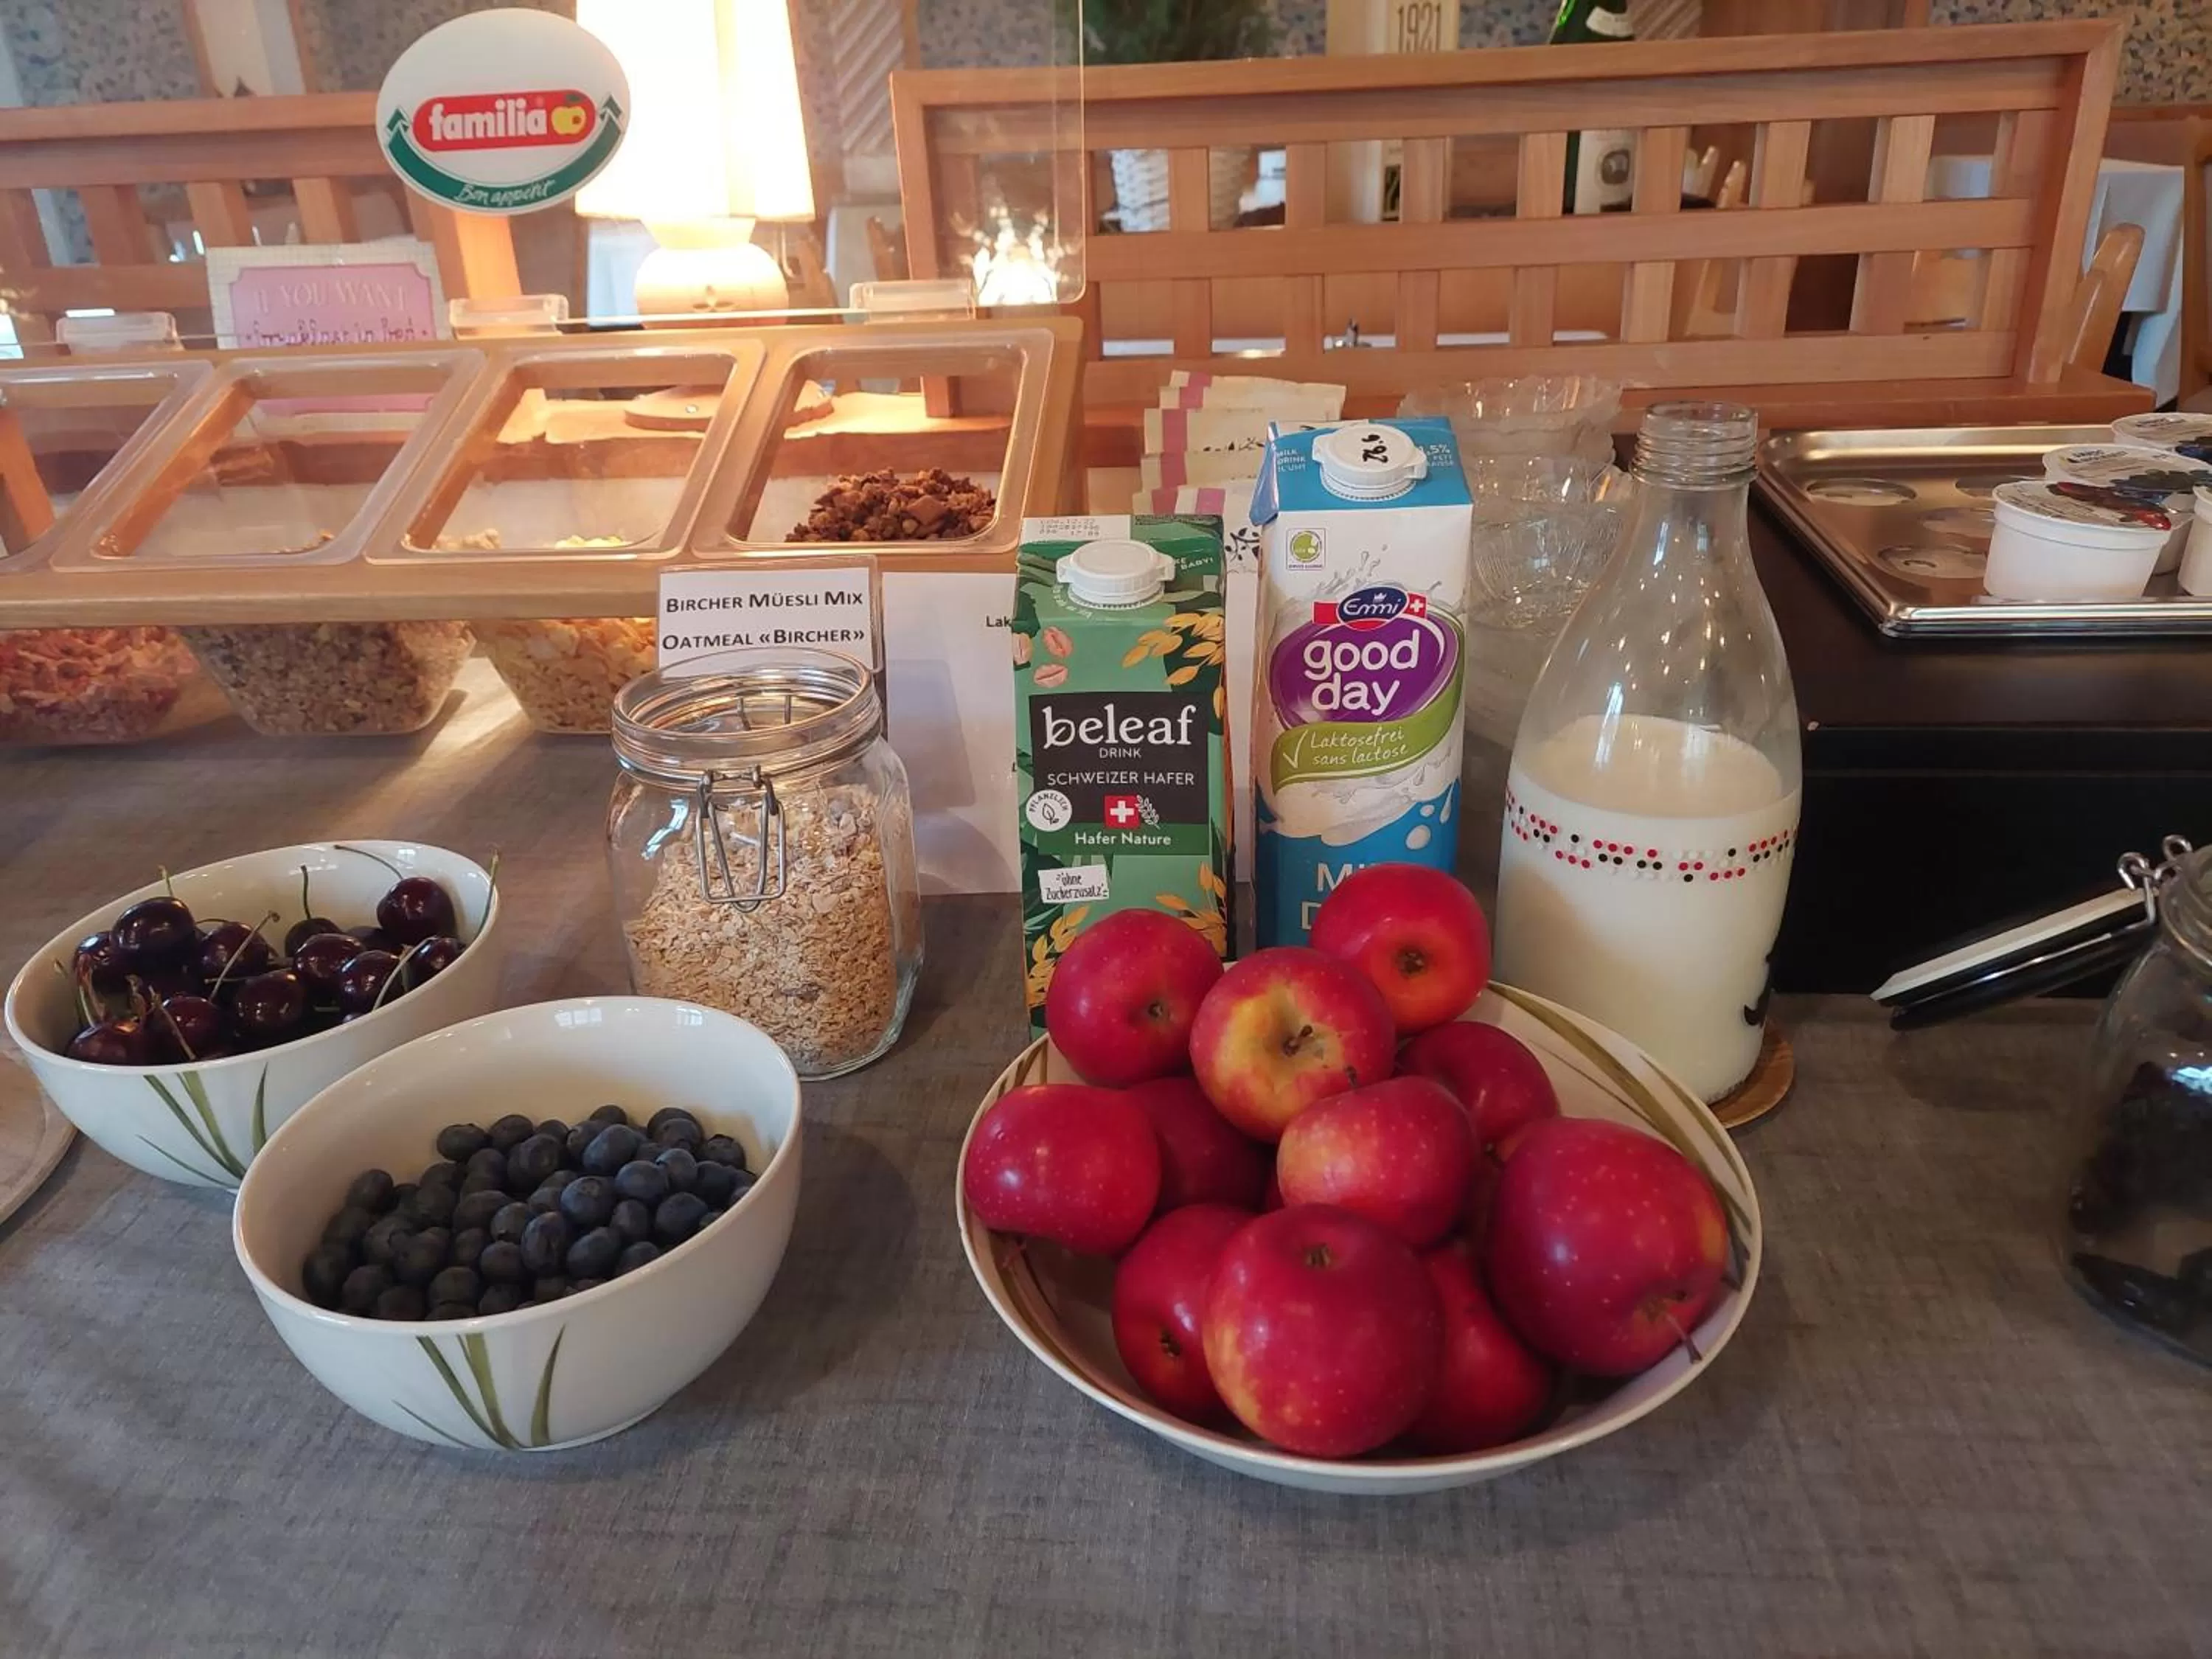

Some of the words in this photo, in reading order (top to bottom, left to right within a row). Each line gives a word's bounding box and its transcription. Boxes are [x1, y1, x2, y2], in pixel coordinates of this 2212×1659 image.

[1397, 3, 1441, 52] 1921
[429, 98, 546, 141] familia
[453, 184, 489, 206] Bon
[666, 596, 743, 613] BIRCHER
[749, 592, 818, 608] MÜESLI
[824, 591, 863, 605] MIX
[1342, 598, 1402, 616] Emmi
[662, 631, 754, 650] OATMEAL
[1303, 629, 1420, 681] good
[1312, 672, 1401, 717] day
[1042, 703, 1197, 750] beleaf
[1310, 726, 1405, 748] Laktosefrei
[1099, 747, 1142, 759] DRINK
[1312, 754, 1346, 765] sans
[1352, 744, 1406, 762] lactose
[1047, 771, 1139, 786] SCHWEIZER
[1144, 771, 1194, 785] HAFER
[1074, 831, 1117, 845] Hafer
[1121, 832, 1172, 846] Nature
